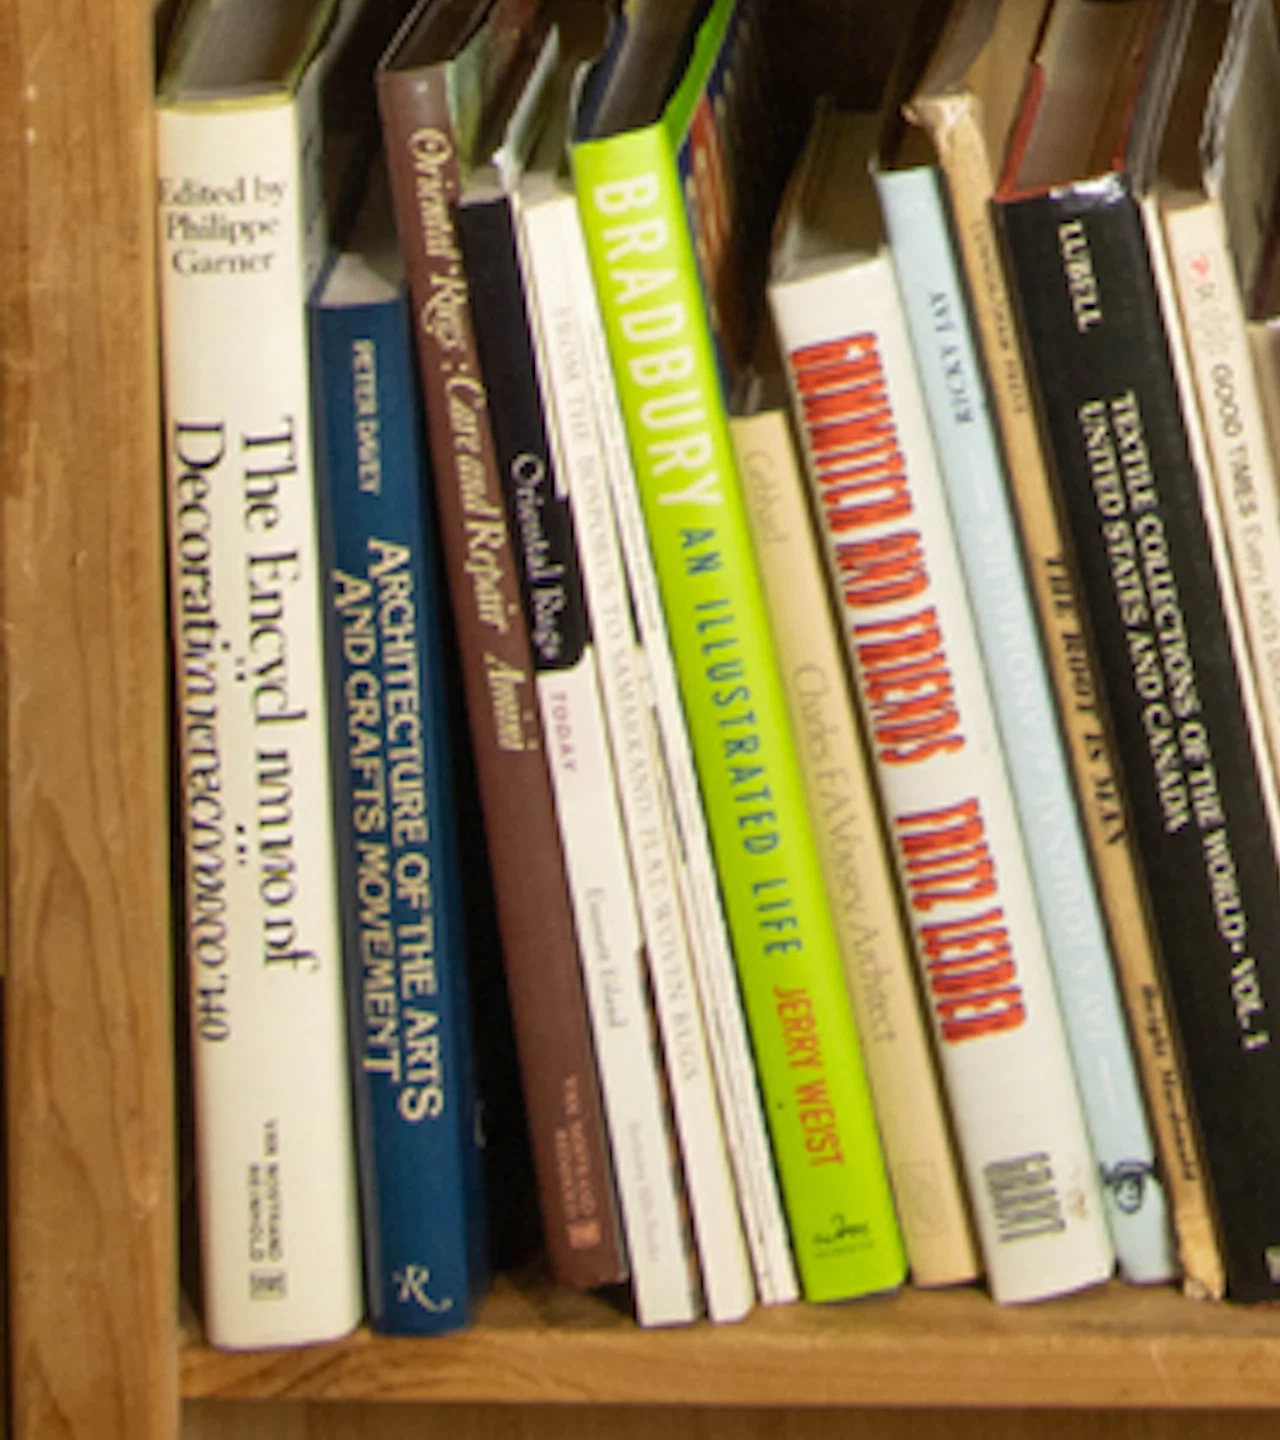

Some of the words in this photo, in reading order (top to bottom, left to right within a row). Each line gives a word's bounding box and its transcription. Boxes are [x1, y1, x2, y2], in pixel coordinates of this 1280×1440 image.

[596, 175, 722, 517] BRADBURY
[677, 525, 729, 578] AN
[335, 570, 375, 665] AND
[366, 538, 429, 846] ARCHITECTURE
[688, 598, 781, 853] ILLUSTRATED
[345, 671, 398, 833] CRAFTS
[397, 852, 433, 908] OF
[752, 875, 803, 955] LIFE
[355, 841, 401, 1084] MOVEMENT
[401, 917, 438, 999] THE
[399, 1007, 445, 1122] ARTS
[774, 984, 828, 1072] JERRY
[793, 1079, 847, 1168] WEIST
